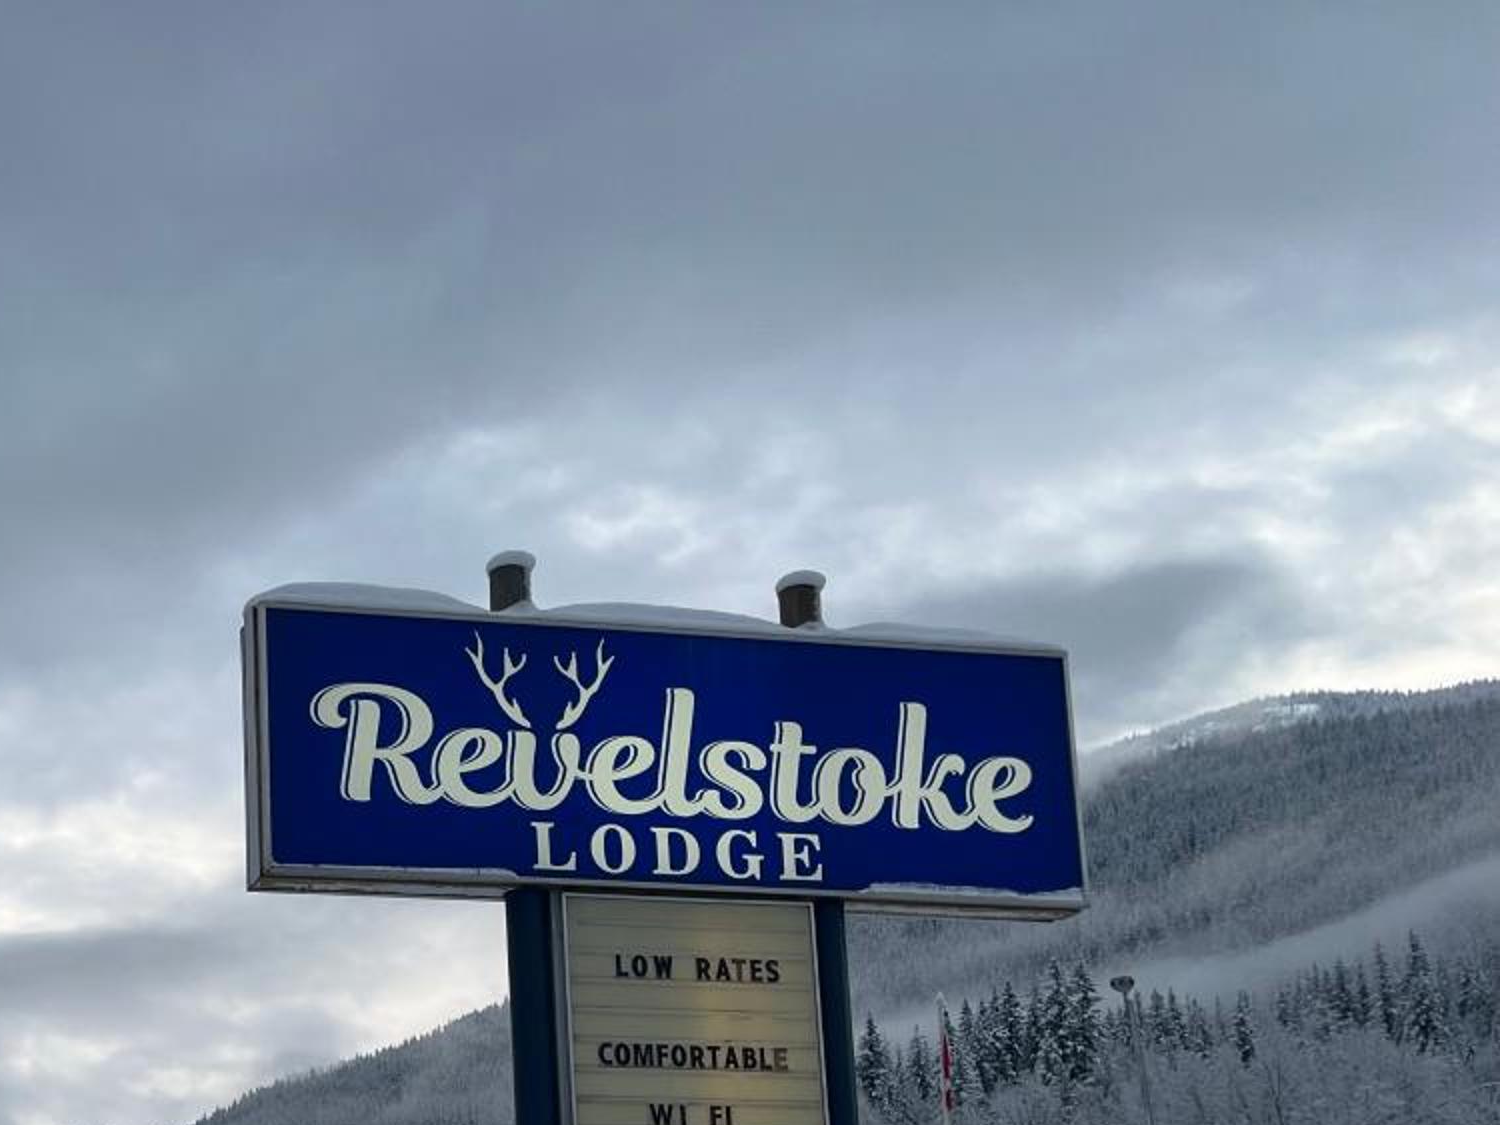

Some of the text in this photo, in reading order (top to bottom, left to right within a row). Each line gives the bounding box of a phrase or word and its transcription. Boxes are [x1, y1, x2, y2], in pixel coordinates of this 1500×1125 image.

[310, 683, 1033, 833] Revelstoke
[530, 821, 823, 881] LODGE
[615, 954, 781, 983] LOW RATES
[598, 1042, 789, 1073] COMFORTABLE
